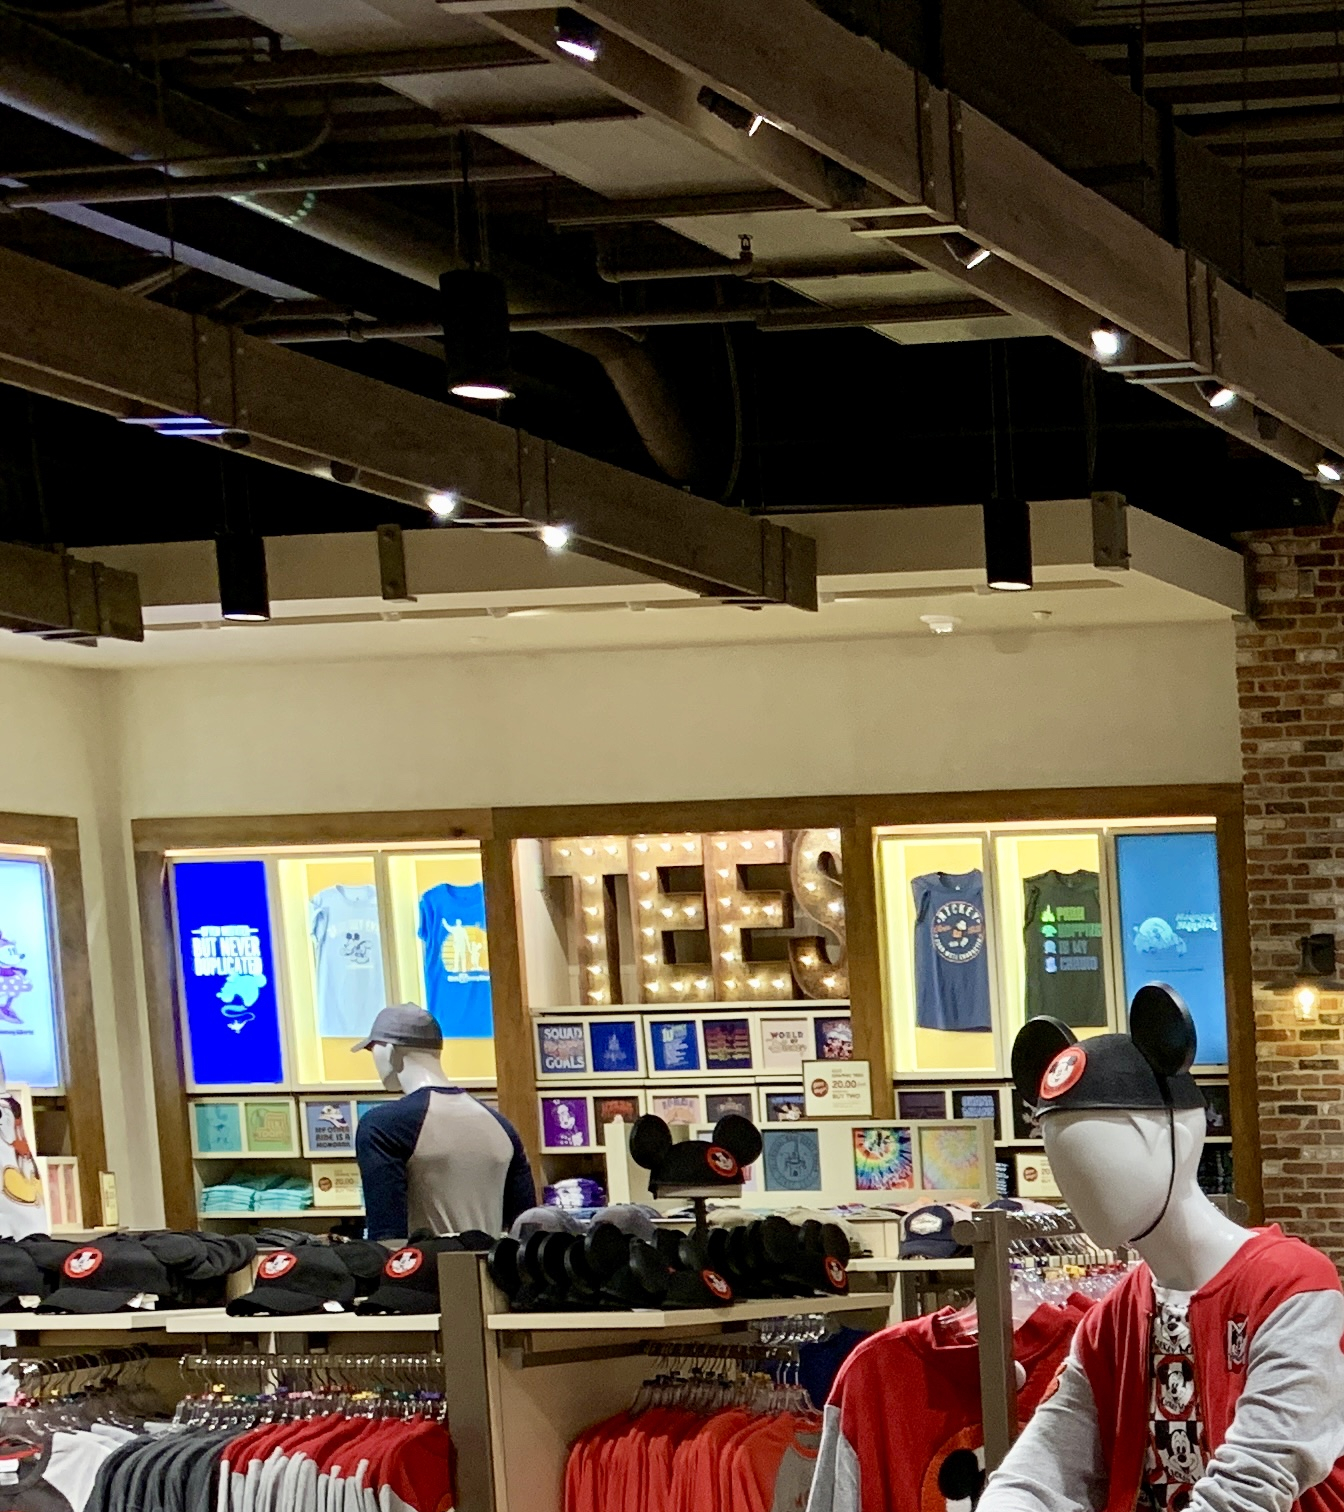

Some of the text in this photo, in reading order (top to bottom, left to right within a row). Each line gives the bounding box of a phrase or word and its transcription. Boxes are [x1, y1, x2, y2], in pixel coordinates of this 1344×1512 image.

[544, 829, 850, 1006] TEES
[220, 935, 261, 957] NEVER
[194, 956, 263, 977] DUPLICATED
[544, 1027, 583, 1040] SQUAD
[546, 1056, 586, 1069] GOALS
[832, 1080, 857, 1089] 20.00
